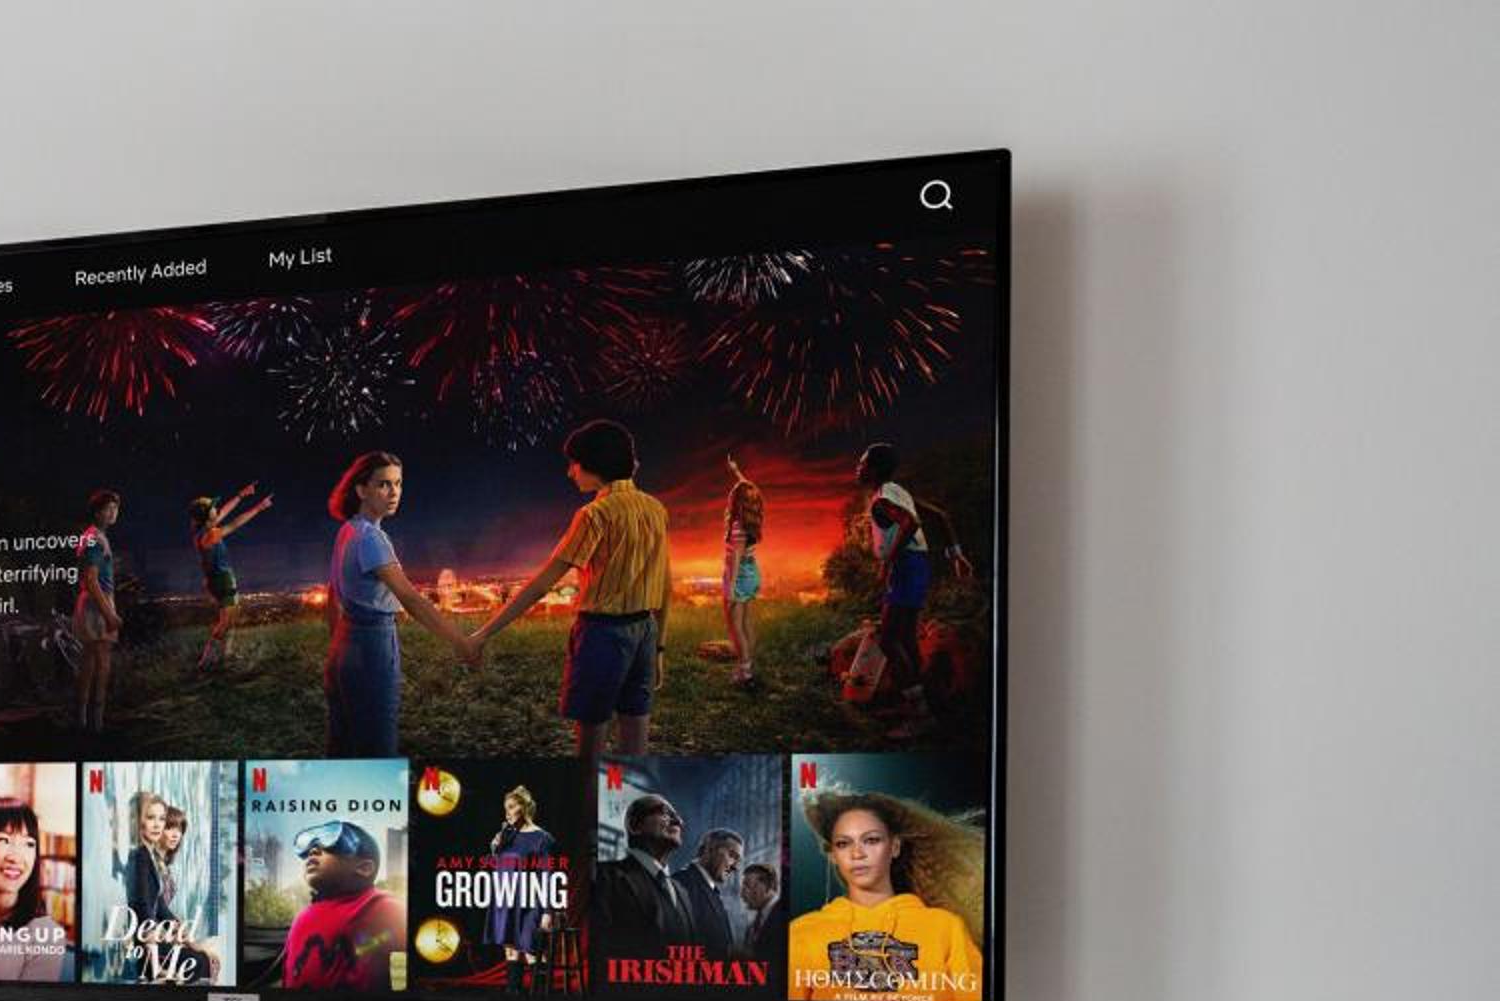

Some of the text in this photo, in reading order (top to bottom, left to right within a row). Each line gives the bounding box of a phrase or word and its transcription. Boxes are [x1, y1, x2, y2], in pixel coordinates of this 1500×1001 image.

[269, 247, 333, 270] My List
[75, 258, 207, 286] Recently Added
[13, 534, 97, 551] uncovers
[89, 769, 104, 794] N
[252, 768, 267, 793] N
[423, 767, 441, 790] N
[607, 765, 623, 791] N
[800, 762, 818, 789] N
[251, 799, 402, 813] RAISING DION
[436, 855, 474, 869] AMY
[435, 870, 568, 909] GROWING
[100, 905, 203, 943] Dead
[125, 942, 197, 982] to Me
[667, 945, 706, 960] THE
[607, 958, 770, 987] IRISHMAN
